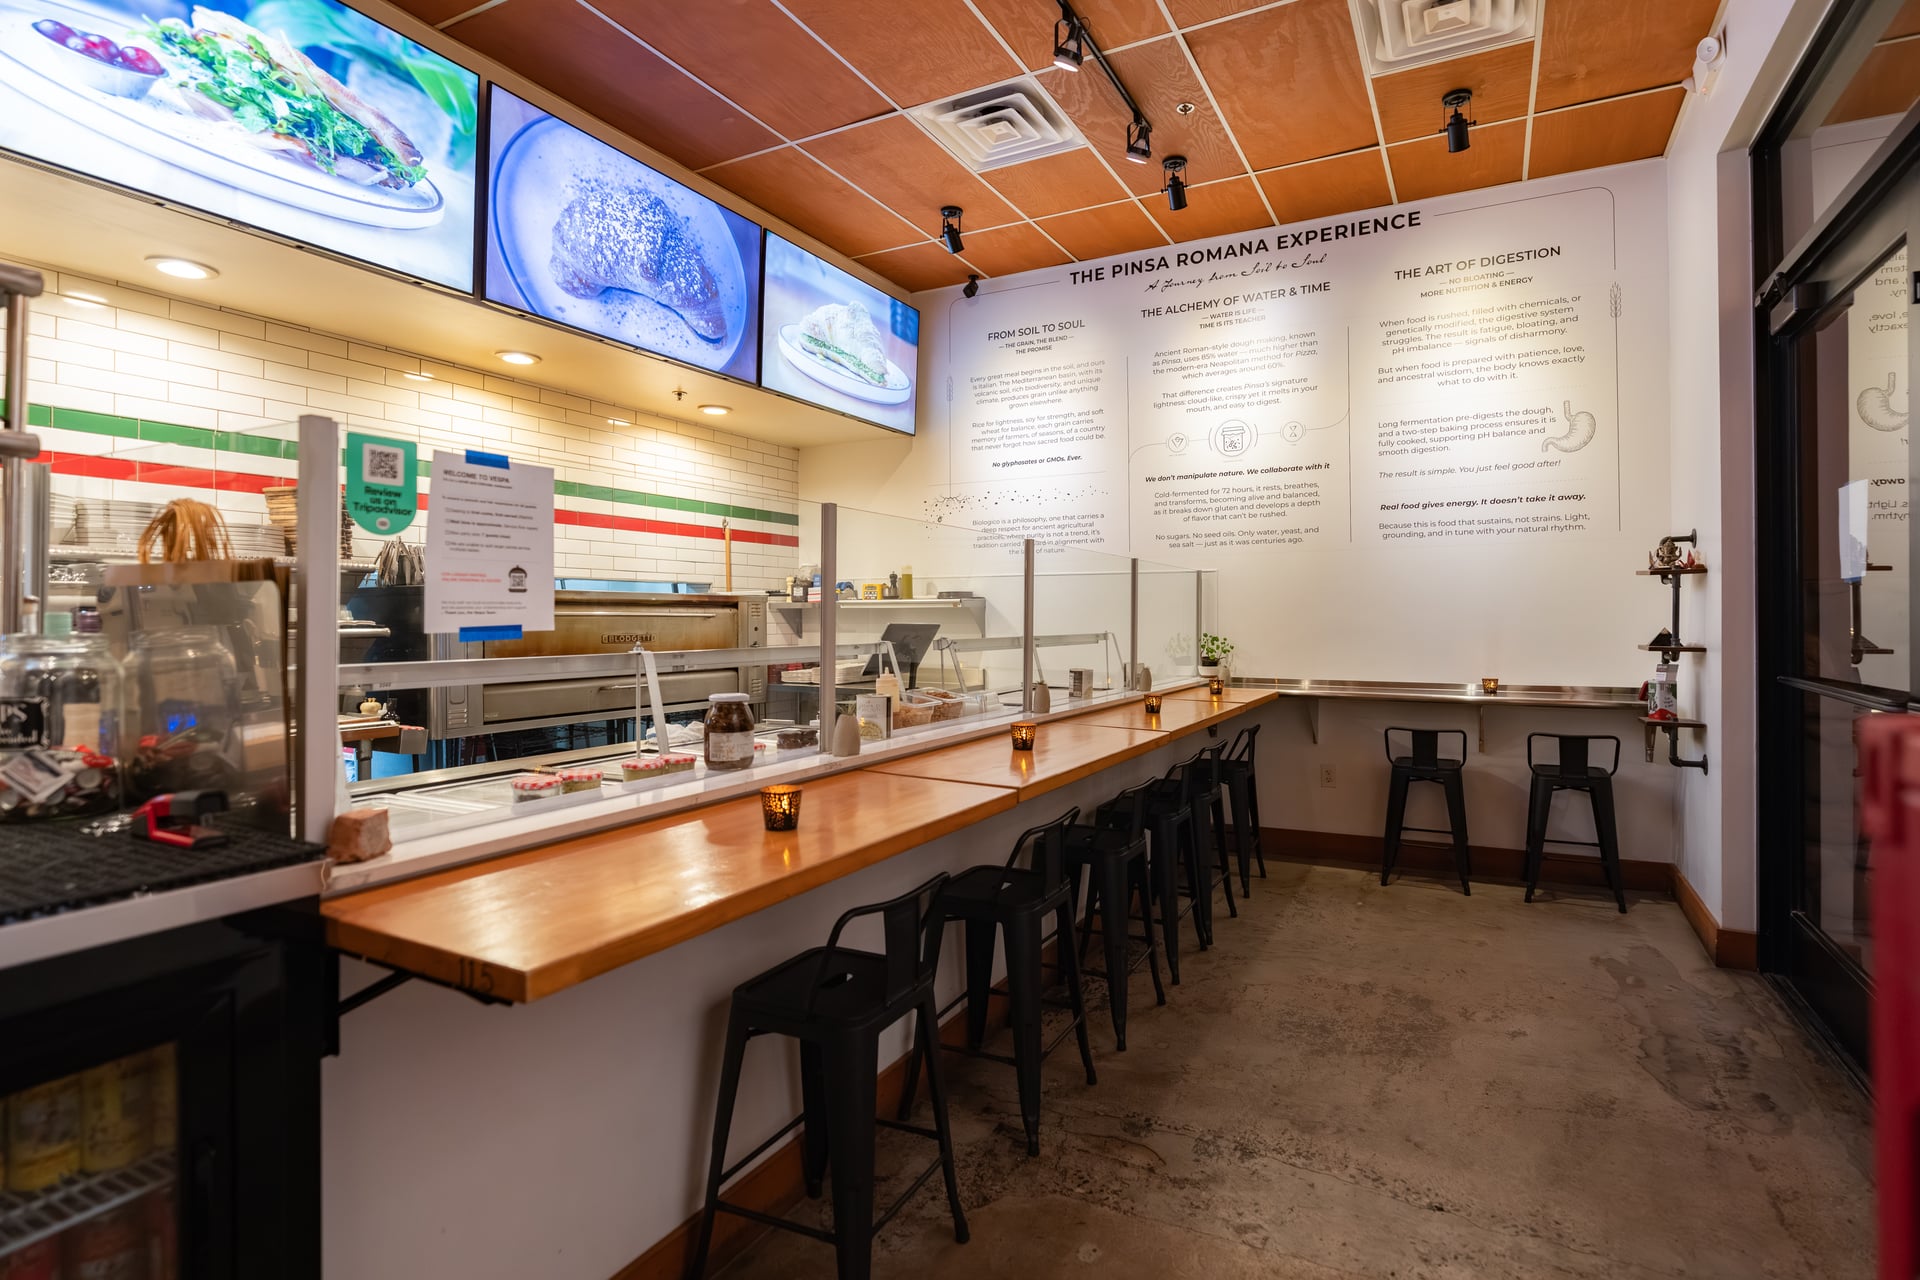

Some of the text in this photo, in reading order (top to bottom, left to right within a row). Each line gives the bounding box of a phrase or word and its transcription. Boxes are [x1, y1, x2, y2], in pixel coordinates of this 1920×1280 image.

[1070, 210, 1421, 285] THE PINSA ROMANA EXPERIENCE
[1394, 246, 1560, 281] THE ART OF DIGESTION
[1145, 253, 1327, 292] A Journey from Soil to Soul
[1449, 270, 1504, 285] NO BLOATING
[1421, 289, 1443, 298] MORE
[1446, 282, 1489, 294] NUTRITION
[1499, 276, 1533, 287] ENERGY
[1141, 282, 1330, 318] THE ALCHEMY OF WATER & TIME
[1210, 311, 1233, 320] WATER
[1234, 314, 1265, 324] TEACHER
[988, 319, 1085, 341] FROM SOIL TO SOUL
[1017, 339, 1036, 347] GRAIN,
[1048, 334, 1068, 342] BLEND
[1027, 344, 1052, 353] PROMISE
[1378, 366, 1393, 375] But
[1394, 364, 1419, 373] when
[1420, 360, 1440, 370] food
[1452, 354, 1492, 368] prepared
[1494, 351, 1517, 362] with
[1518, 348, 1561, 361] patience,
[1563, 346, 1584, 354] love,
[1378, 405, 1554, 429] Long fermentation pre-digests the dough,
[1378, 429, 1394, 438] and
[1401, 427, 1439, 436] two-step
[1440, 424, 1468, 433] baking
[1470, 421, 1503, 432] process
[1505, 418, 1540, 427] ensures
[1378, 426, 1546, 448] fully cooked, supporting pH balance and
[1378, 444, 1450, 456] smooth digestion.
[1001, 460, 1037, 468] glyphosates
[1427, 467, 1456, 475] simple.
[1475, 465, 1492, 474] just
[1512, 461, 1535, 471] good
[1537, 460, 1561, 468] after!
[443, 469, 476, 479] WELCOME
[1177, 472, 1218, 480] manipulate
[364, 486, 402, 498] Review
[1155, 488, 1209, 498] Cold-fermented
[1284, 481, 1319, 490] breathes,
[353, 502, 412, 516] Tripadvisor
[370, 497, 397, 507] us on
[1422, 501, 1444, 510] gives
[1490, 496, 1523, 504] doesn't
[1379, 522, 1413, 530] Because
[1413, 520, 1429, 528] this
[1438, 518, 1457, 527] food
[1457, 518, 1476, 526] that
[1476, 516, 1514, 525] sustains,
[1531, 514, 1564, 523] strains.
[1564, 512, 1590, 522] Light,
[1166, 534, 1191, 542] sugars.
[1204, 530, 1222, 538] seed
[1237, 529, 1256, 538] Only
[1256, 528, 1279, 536] water,
[1281, 527, 1302, 536] yeast,
[1382, 530, 1426, 541] grounding,
[1427, 528, 1444, 537] and
[1454, 528, 1474, 536] tune
[1475, 526, 1494, 535] with
[1495, 527, 1516, 536] your
[1518, 524, 1548, 533] natural
[1549, 523, 1585, 533] rhythm.
